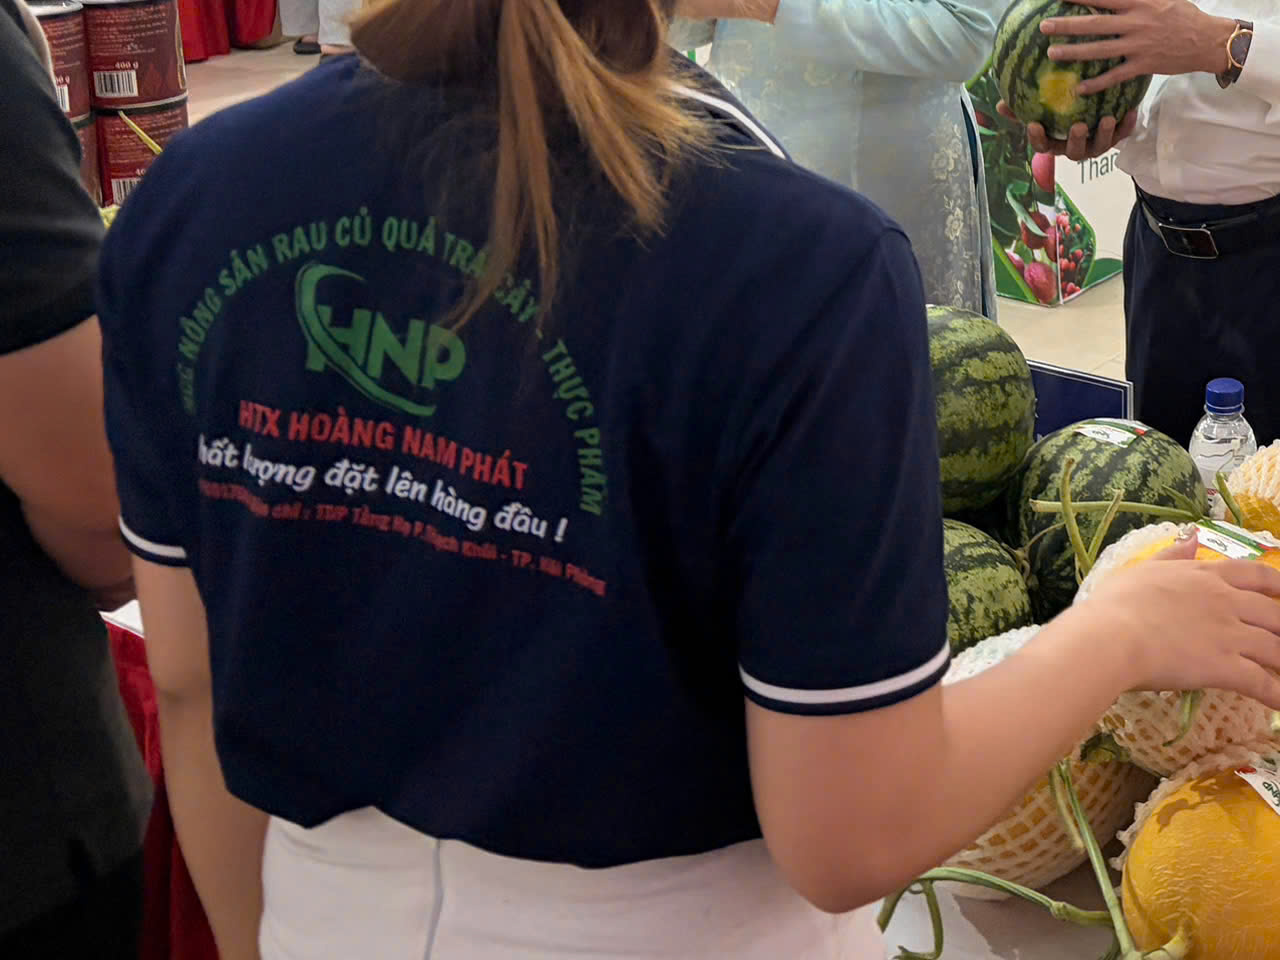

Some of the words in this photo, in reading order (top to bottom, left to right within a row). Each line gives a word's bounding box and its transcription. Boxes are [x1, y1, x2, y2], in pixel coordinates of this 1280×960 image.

[178, 287, 222, 361] NÔNG
[218, 243, 269, 297] SẢN
[271, 221, 327, 264] RAU
[335, 206, 372, 248] CỦ
[541, 338, 595, 421] THỰC
[305, 303, 467, 391] HNP
[238, 399, 281, 438] HTX
[287, 405, 396, 451] HOÀNG
[401, 425, 458, 470] NAM
[459, 448, 529, 490] PHÁT
[242, 442, 317, 492] lượng
[324, 458, 380, 495] đặt
[384, 465, 428, 503] lên
[430, 479, 488, 532] hàng
[493, 501, 548, 539] đầu
[554, 517, 569, 543] !
